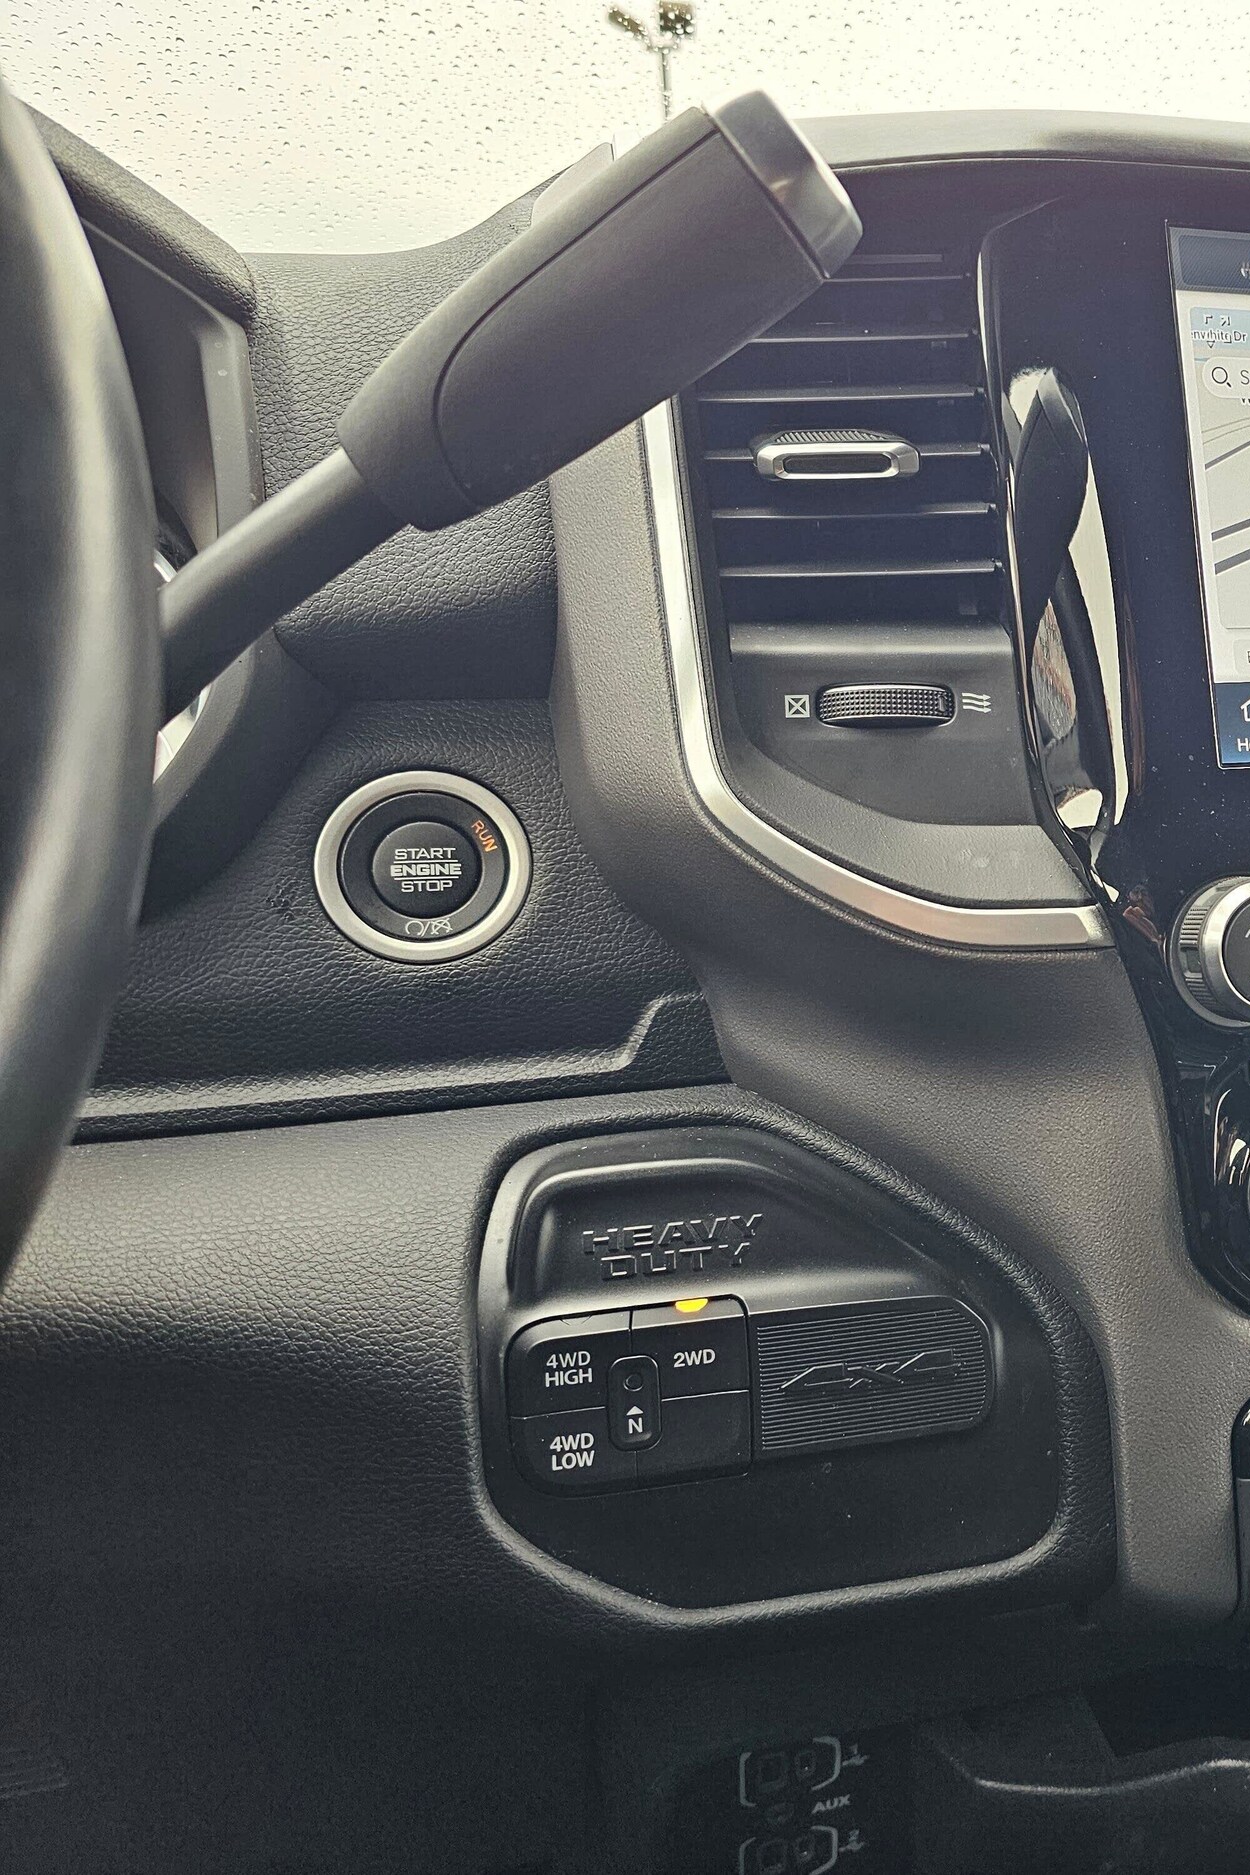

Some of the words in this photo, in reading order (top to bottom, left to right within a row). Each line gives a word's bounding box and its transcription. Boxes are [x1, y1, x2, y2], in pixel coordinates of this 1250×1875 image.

[1233, 330, 1247, 342] Dr
[471, 819, 498, 852] RUN
[394, 847, 456, 860] START
[390, 863, 462, 877] ENGINE
[401, 879, 453, 893] STOP
[582, 1213, 763, 1255] HEAVY
[600, 1241, 751, 1281] DUTY
[545, 1350, 591, 1369] 4WD
[673, 1348, 716, 1368] 2WD
[544, 1367, 593, 1388] HIGH
[628, 1417, 643, 1434] N
[549, 1432, 595, 1452] 4WD
[551, 1450, 595, 1471] LOW
[811, 1793, 851, 1815] AUX
